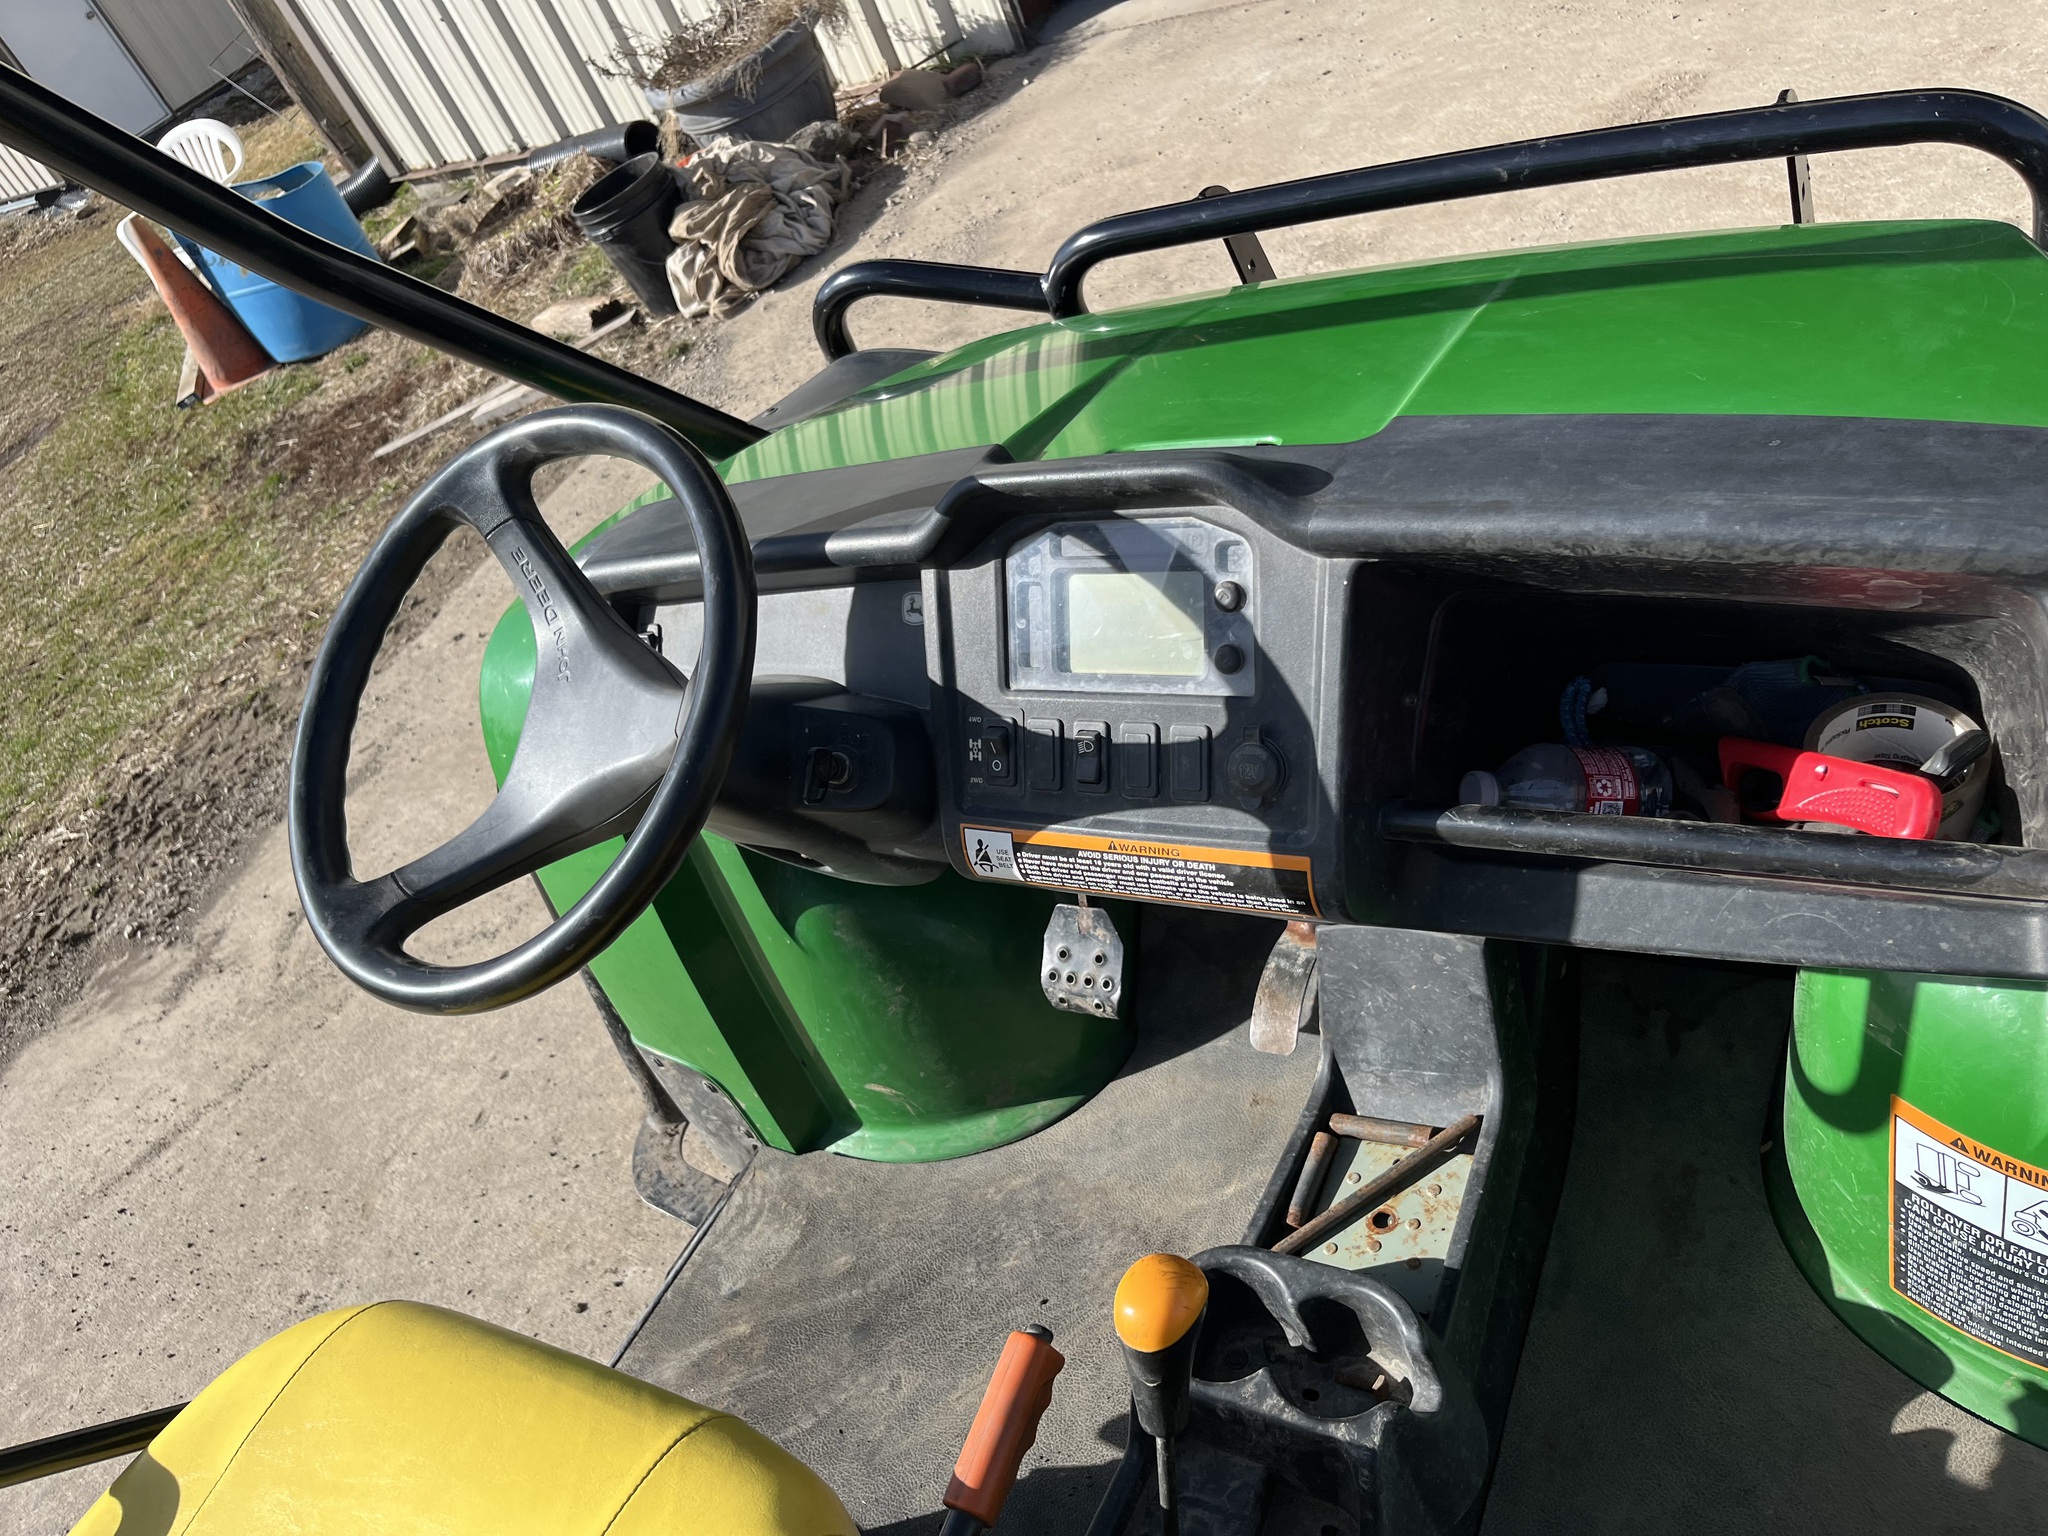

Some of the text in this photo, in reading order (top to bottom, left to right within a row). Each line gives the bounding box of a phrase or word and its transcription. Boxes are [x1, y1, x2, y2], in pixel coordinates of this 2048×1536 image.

[511, 547, 571, 683] JOHN DEERE
[1859, 717, 1910, 728] Scotch
[1239, 764, 1260, 780] 12V
[1078, 850, 1101, 858] AVOID
[1103, 853, 1138, 863] SERIOUS
[1140, 856, 1170, 866] INJURY
[1187, 862, 1216, 871] DEATH
[1119, 844, 1180, 856] WARNING
[1083, 871, 1116, 879] passenger
[1150, 872, 1185, 881] passenger
[1199, 871, 1226, 879] license
[1973, 1146, 2048, 1187] WARNIN
[1904, 1198, 2048, 1276] CAN CAUSE INJURY O
[1908, 1218, 1965, 1256] Use seat belts.
[1908, 1210, 2029, 1278] Watch video and read operator's
[1912, 1193, 2048, 1267] ROLLOVER OR FALL
[1908, 1225, 1929, 1241] Avoid
[1931, 1240, 1968, 1264] excessive
[1971, 1262, 1996, 1277] speed
[1998, 1274, 2014, 1286] and
[2016, 1282, 2041, 1296] sharp
[1908, 1230, 1918, 1241] Be
[1920, 1240, 1946, 1258] careful
[1948, 1256, 1962, 1267] and
[1964, 1265, 1984, 1278] slow
[1986, 1276, 2008, 1290] down
[2010, 1286, 2034, 1300] when
[1908, 1245, 1921, 1257] Use
[1924, 1255, 1948, 1274] brakes
[1950, 1272, 1973, 1288] going
[1975, 1284, 1997, 1298] down
[1908, 1239, 2045, 1311] difficult operating at night
[1926, 1263, 1948, 1280] speed
[1908, 1264, 1925, 1280] Keep
[1928, 1278, 1947, 1292] arms
[1948, 1290, 1962, 1301] and
[1965, 1298, 1982, 1311] legs
[1984, 1306, 1992, 1316] in
[1995, 1313, 2021, 1330] during
[1920, 1266, 1939, 1281] more
[1960, 1290, 1974, 1300] one
[1977, 1298, 2001, 1313] driver
[2003, 1310, 2019, 1320] and
[2021, 1318, 2037, 1328] one
[1930, 1286, 1959, 1305] operate
[1961, 1304, 1990, 1322] vehicle
[1992, 1318, 2016, 1333] under
[2018, 1330, 2032, 1340] the
[1931, 1306, 1952, 1321] roads
[1954, 1319, 1962, 1327] or
[1952, 1311, 1966, 1322] use
[1990, 1330, 2004, 1341] Not
[2006, 1337, 2044, 1357] intended
